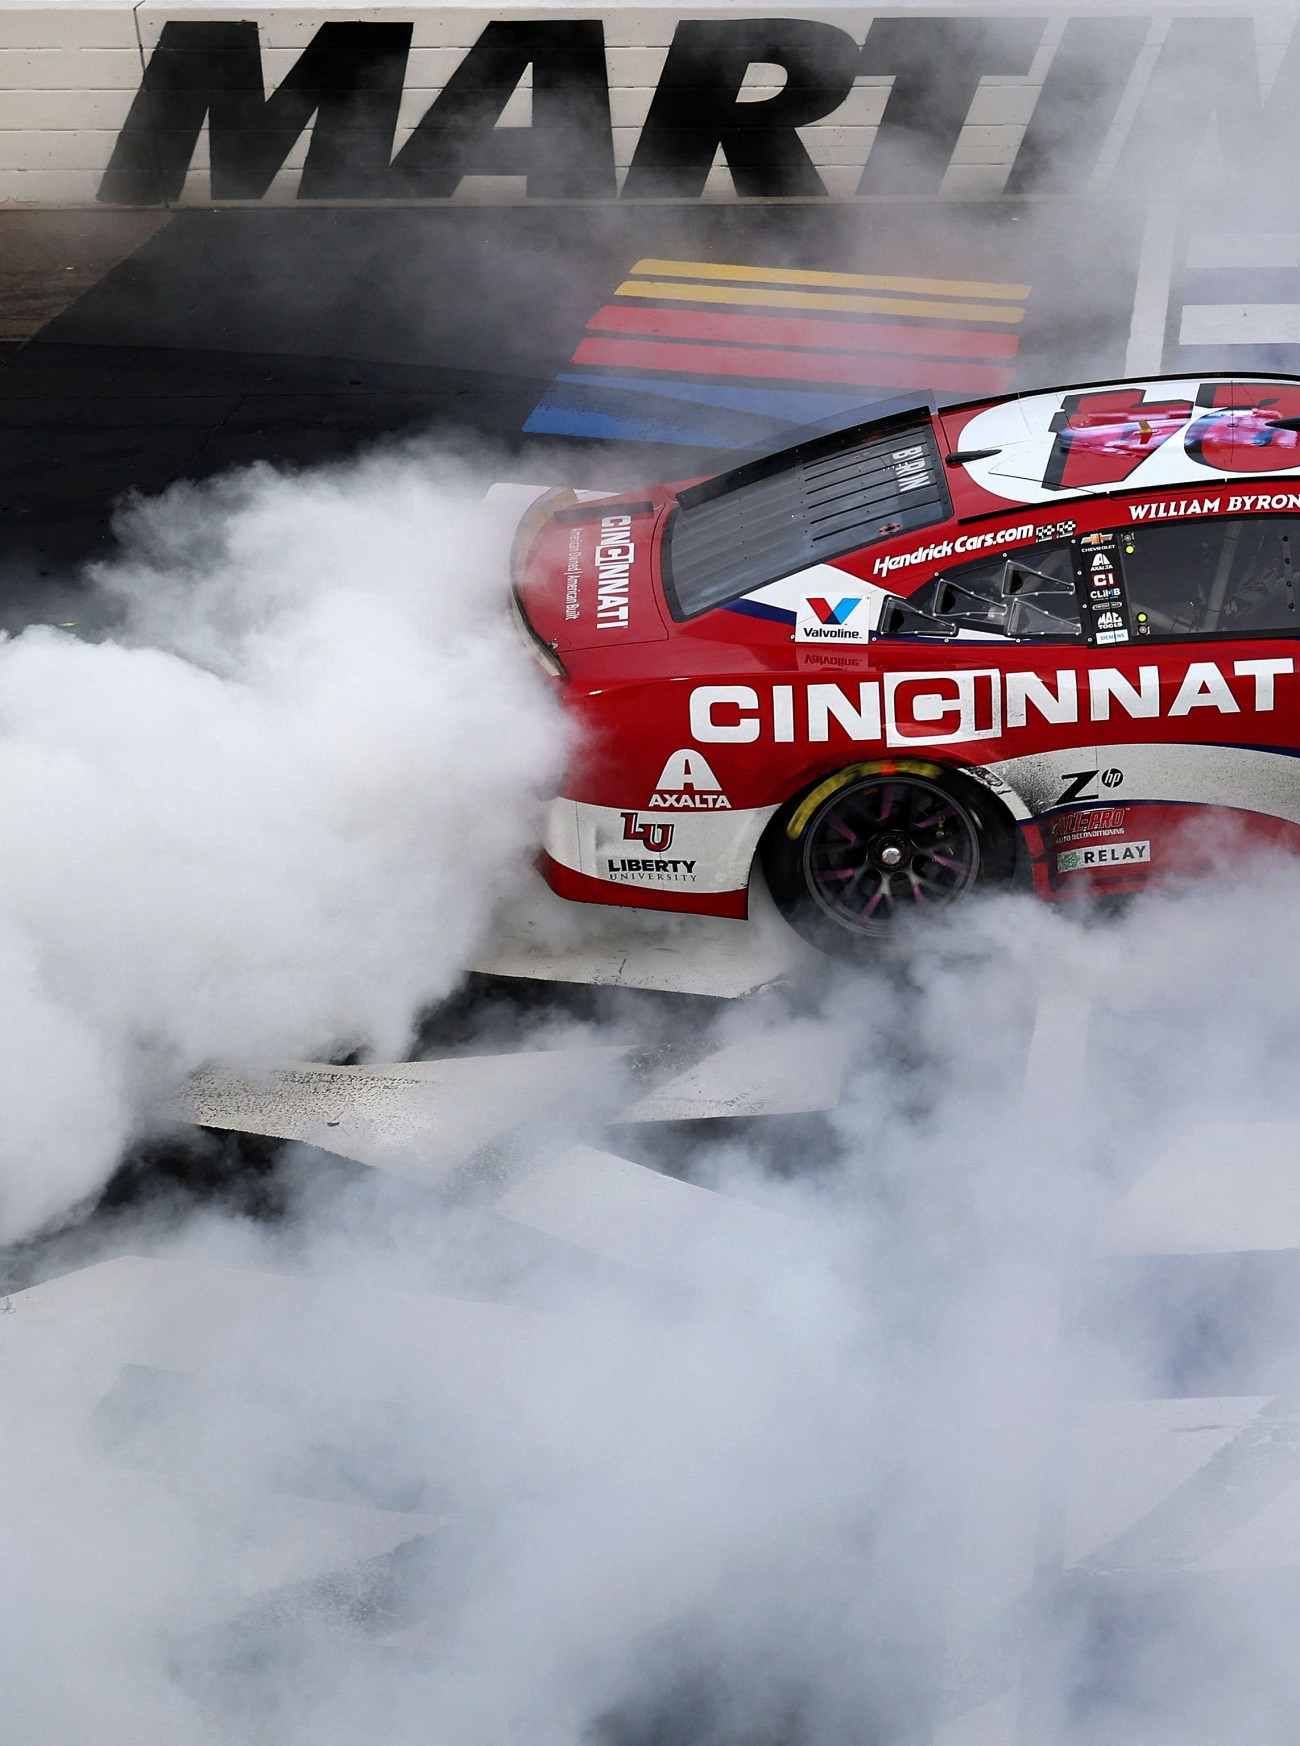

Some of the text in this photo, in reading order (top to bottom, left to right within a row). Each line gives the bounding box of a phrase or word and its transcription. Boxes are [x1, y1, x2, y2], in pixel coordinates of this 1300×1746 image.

[1129, 497, 1221, 520] WILLIAM
[595, 515, 634, 629] CINCINNATI
[1093, 573, 1115, 587] CI
[1098, 612, 1123, 625] MAC
[1099, 622, 1123, 630] TOOLS
[1102, 768, 1123, 788] hp
[648, 794, 732, 809] AXALTA
[1083, 845, 1146, 863] RELAY
[607, 859, 697, 873] LIBERTY
[609, 872, 697, 882] UNIVERSITY
